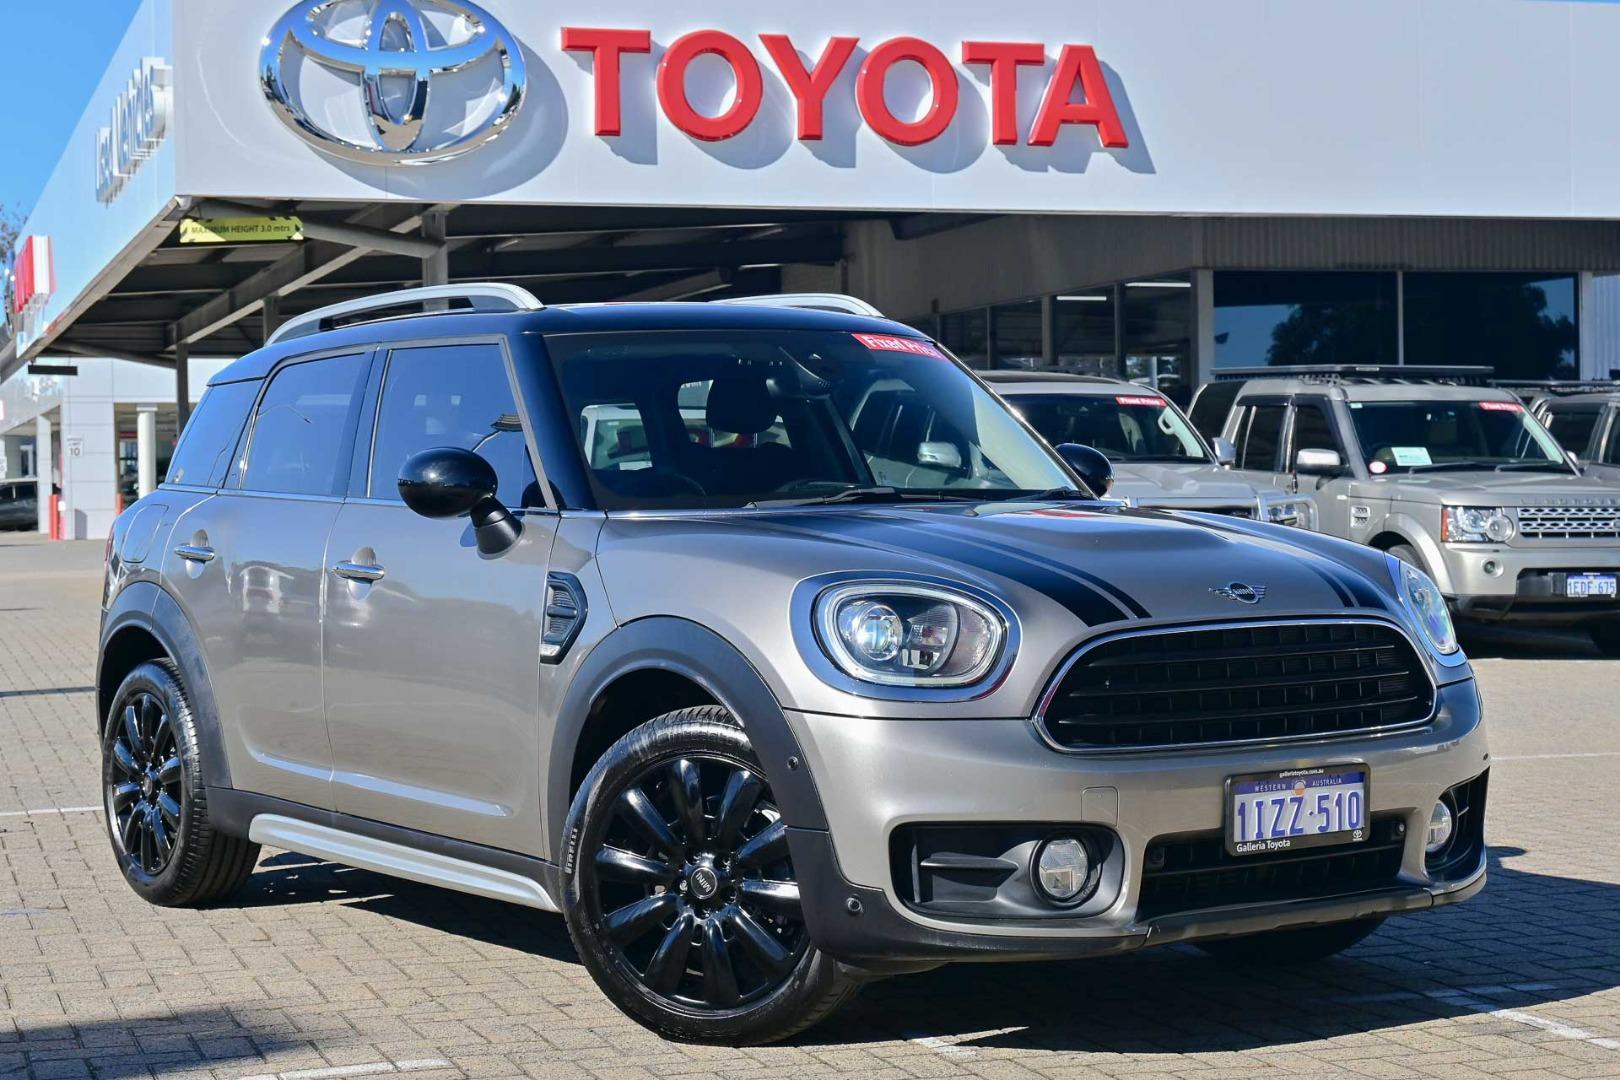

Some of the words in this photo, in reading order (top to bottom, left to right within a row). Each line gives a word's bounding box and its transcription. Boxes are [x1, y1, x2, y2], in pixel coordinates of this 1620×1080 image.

[561, 26, 1128, 148] TOYOTA
[192, 224, 230, 234] MAXIMUM
[231, 225, 259, 234] HEIGHT
[261, 225, 272, 233] 3.0
[861, 336, 907, 351] Fixed
[70, 447, 80, 456] 10
[1254, 784, 1287, 793] WESTERN
[1312, 778, 1342, 787] AUSTRALIA
[1236, 840, 1266, 853] Galleria
[1267, 839, 1291, 851] Toyota
[695, 871, 712, 893] MINI
